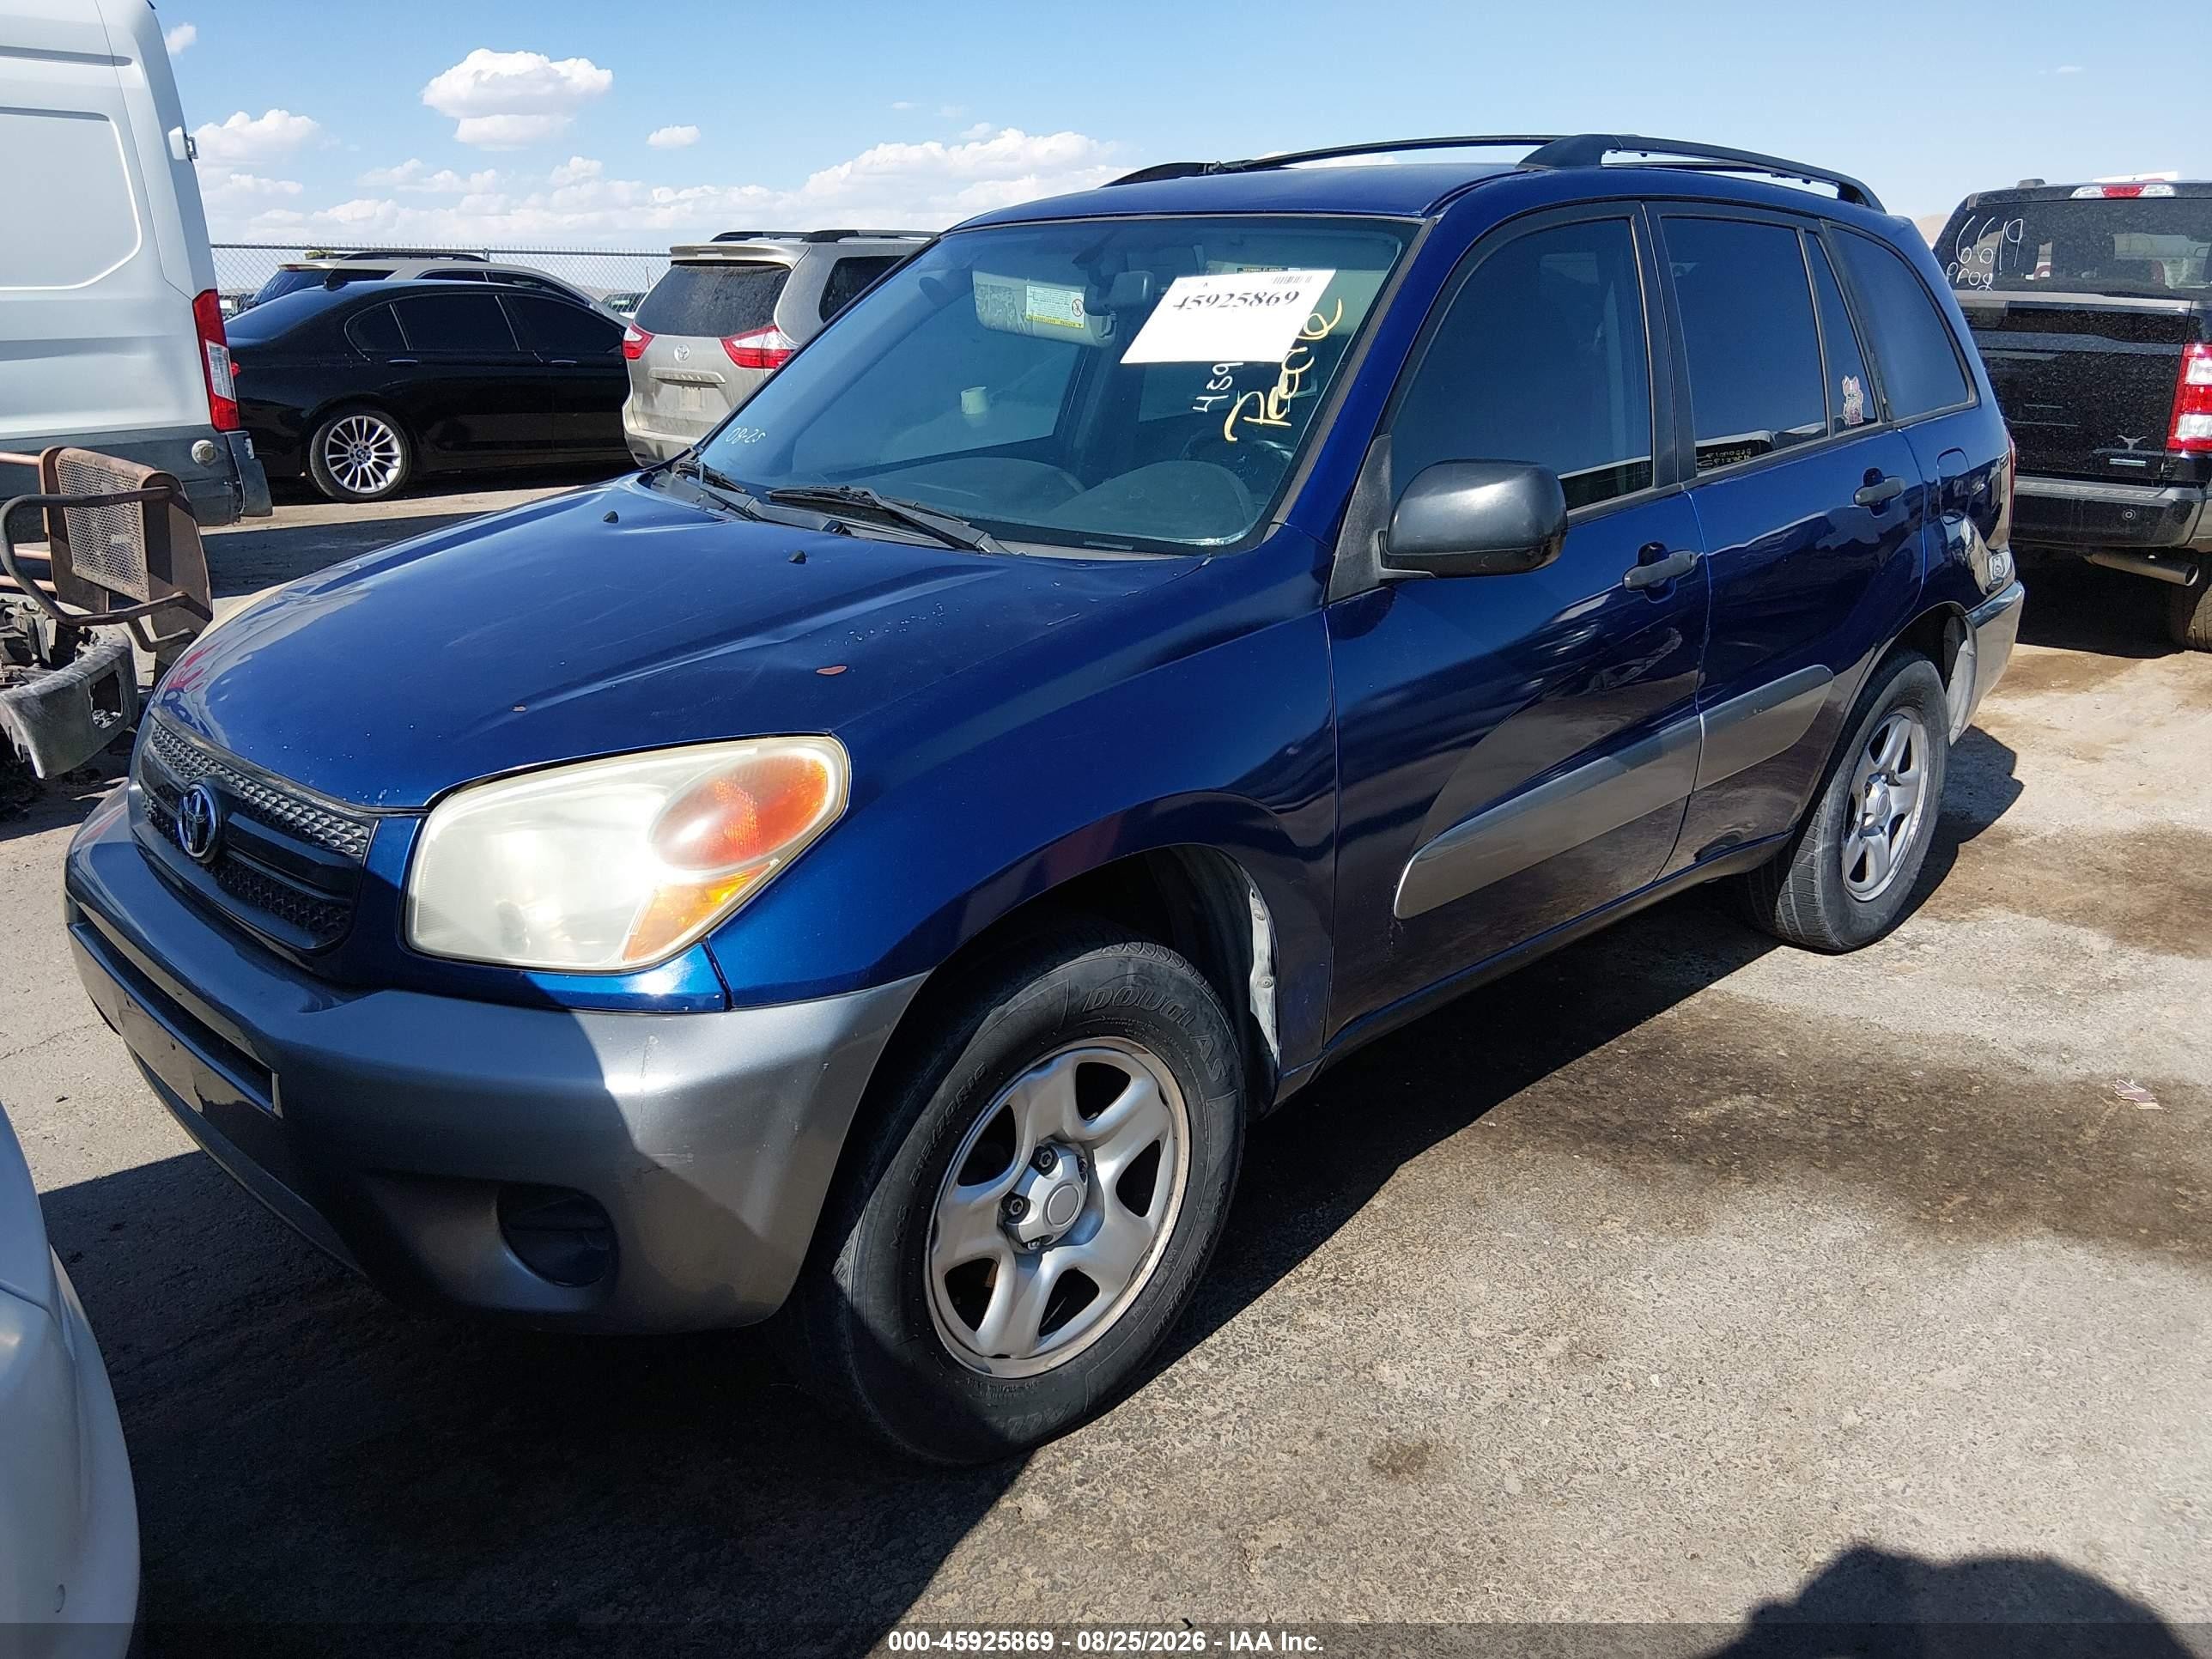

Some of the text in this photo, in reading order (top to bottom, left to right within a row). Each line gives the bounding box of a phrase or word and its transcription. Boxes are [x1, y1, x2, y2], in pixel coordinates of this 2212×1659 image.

[1955, 215, 2024, 271] 6619
[1173, 291, 1300, 310] 45925869
[1082, 986, 1228, 1083] DOUGLAS
